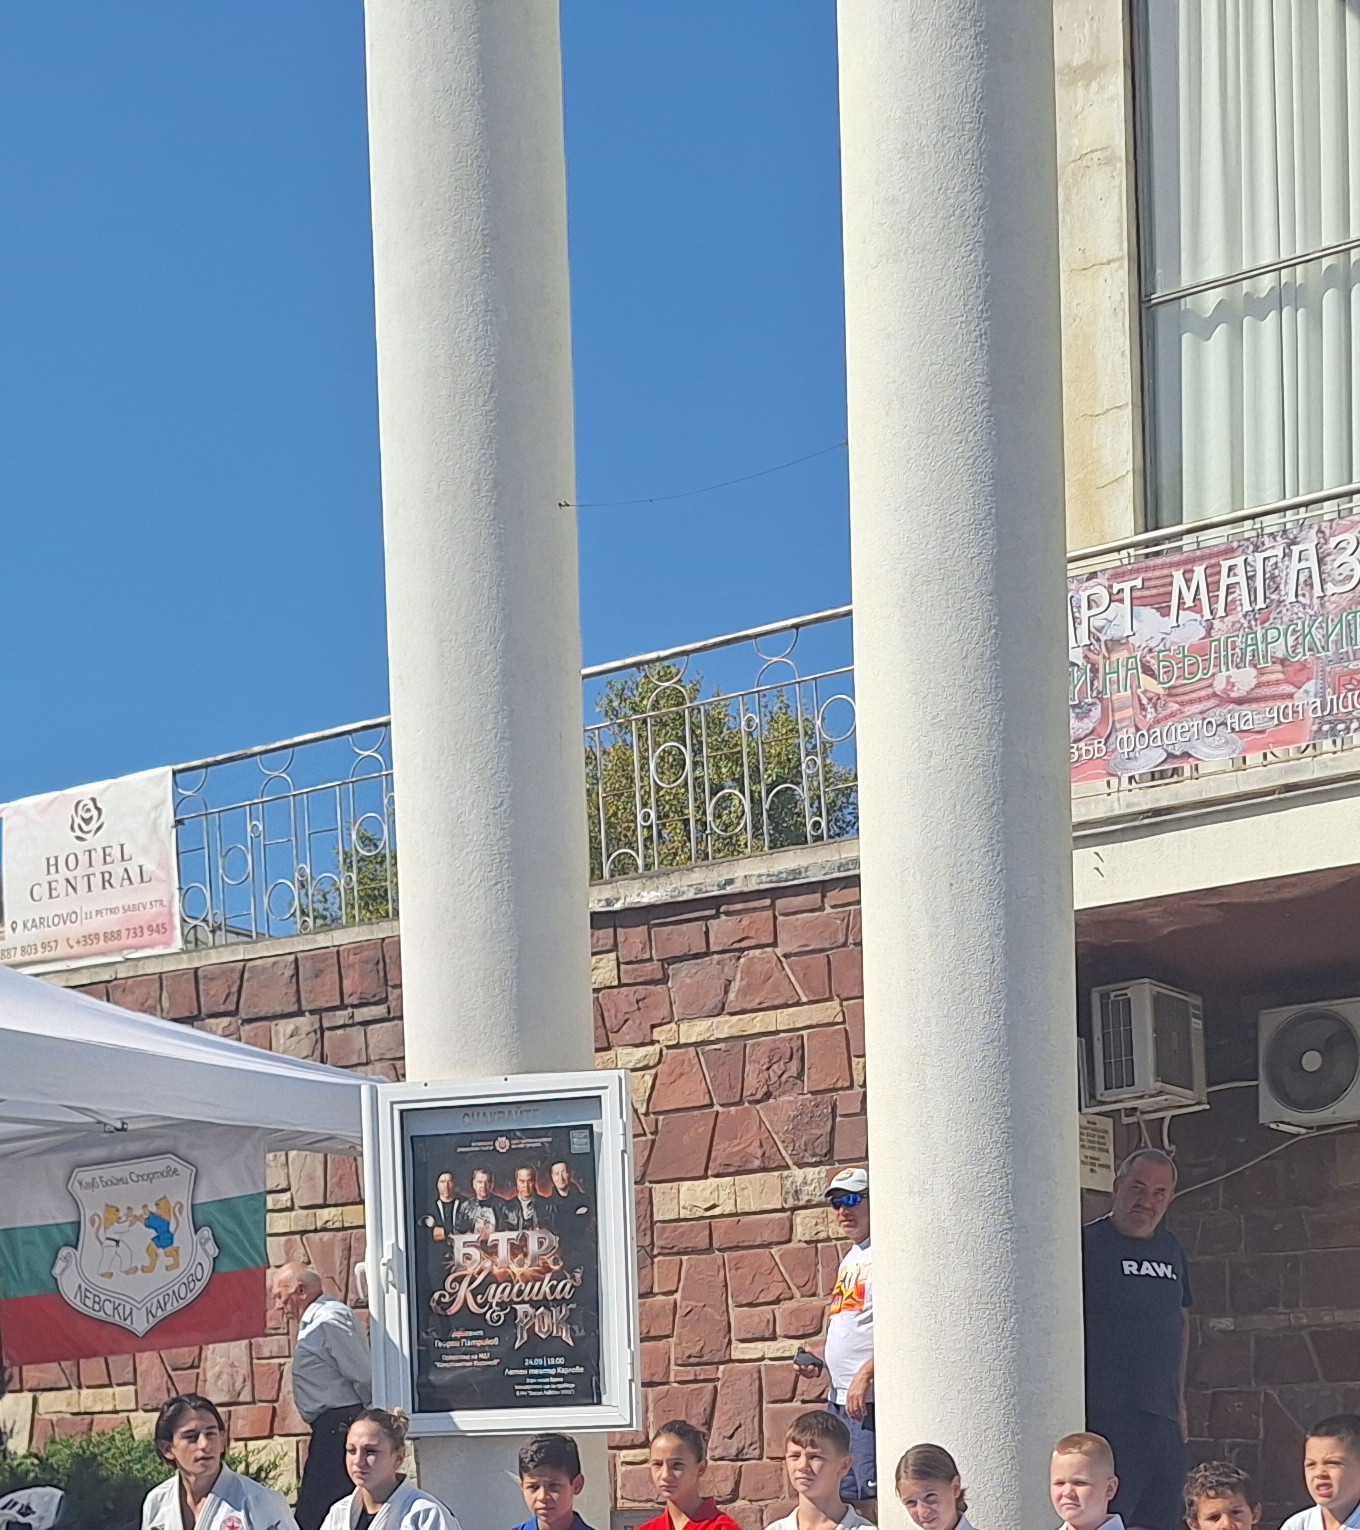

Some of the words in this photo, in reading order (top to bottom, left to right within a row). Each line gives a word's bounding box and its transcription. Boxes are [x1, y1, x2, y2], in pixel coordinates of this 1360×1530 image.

[1101, 654, 1143, 698] НА
[1226, 710, 1255, 734] на
[44, 842, 133, 876] HOTEL
[29, 864, 153, 903] CENTRAL
[22, 911, 78, 932] KARLOVO
[95, 907, 120, 918] PETKO
[122, 902, 148, 914] SABEV
[0, 947, 17, 960] 887
[20, 944, 38, 957] 803
[40, 940, 59, 954] 957
[75, 934, 101, 947] +359
[103, 930, 122, 944] 888
[125, 926, 144, 940] 733
[147, 922, 168, 936] 945
[1121, 1259, 1177, 1280] RAW.
[74, 1283, 134, 1325] ЛЕВСКИ
[145, 1262, 205, 1324] КАРЛОВО
[429, 1268, 576, 1317] Класика
[512, 1303, 578, 1350] РОК
